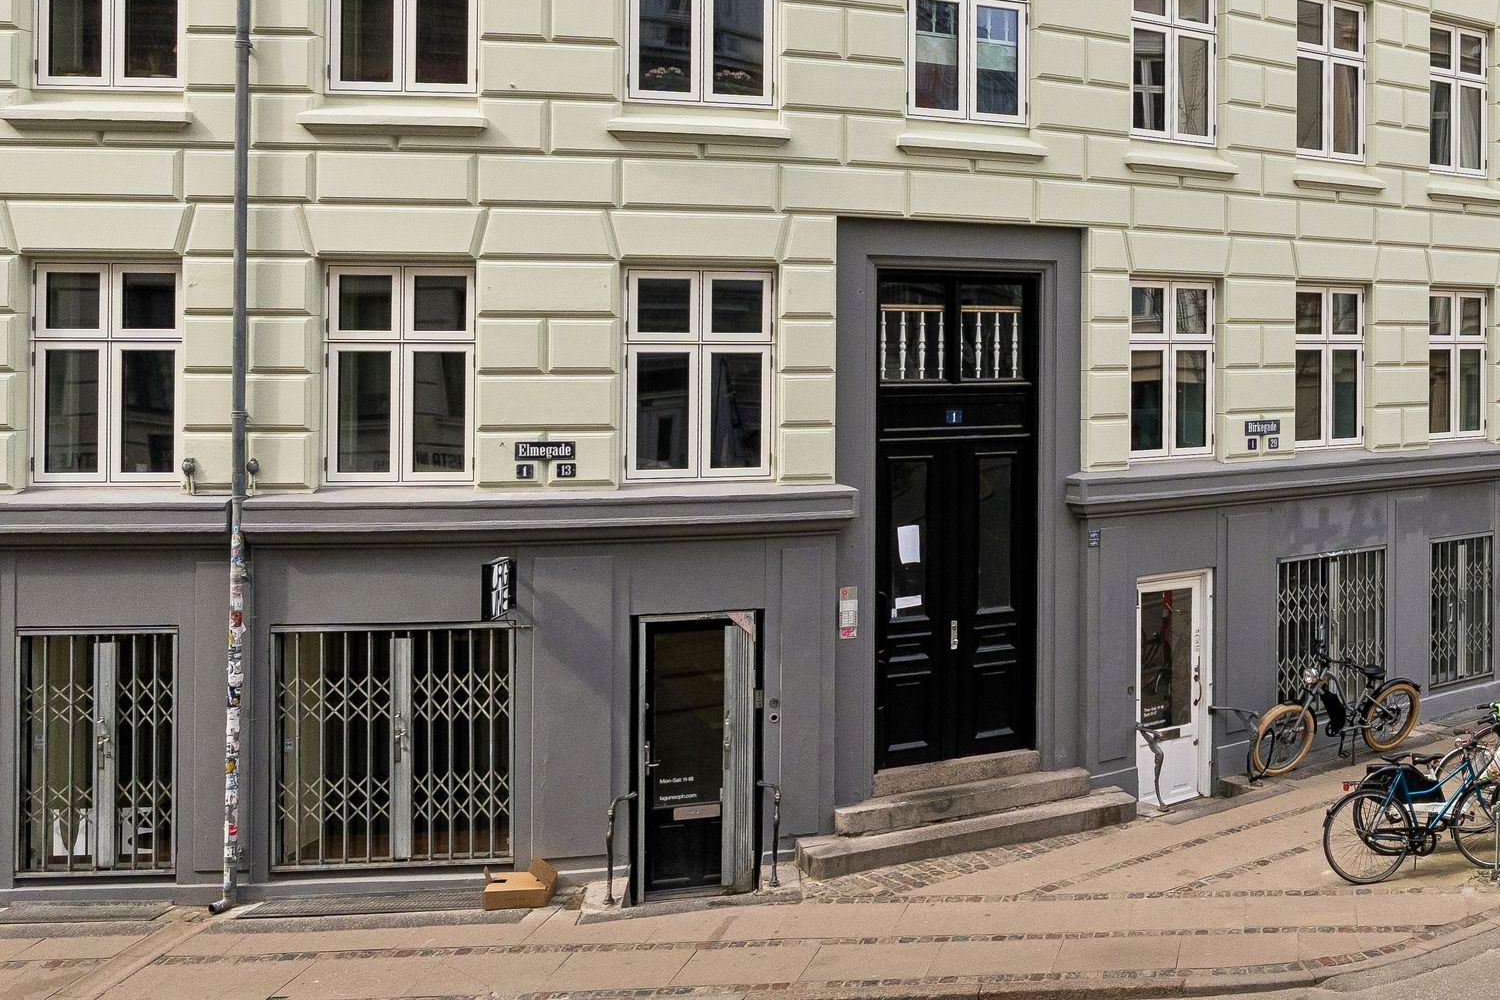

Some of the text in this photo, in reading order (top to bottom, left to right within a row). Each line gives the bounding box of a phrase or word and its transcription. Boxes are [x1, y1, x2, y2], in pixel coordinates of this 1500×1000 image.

[952, 411, 956, 423] 1
[1248, 421, 1277, 434] Birkegade
[1251, 439, 1255, 449] 1
[1270, 439, 1278, 448] 29
[518, 443, 571, 459] Elmegade
[522, 466, 527, 477] 1
[561, 465, 571, 476] 13
